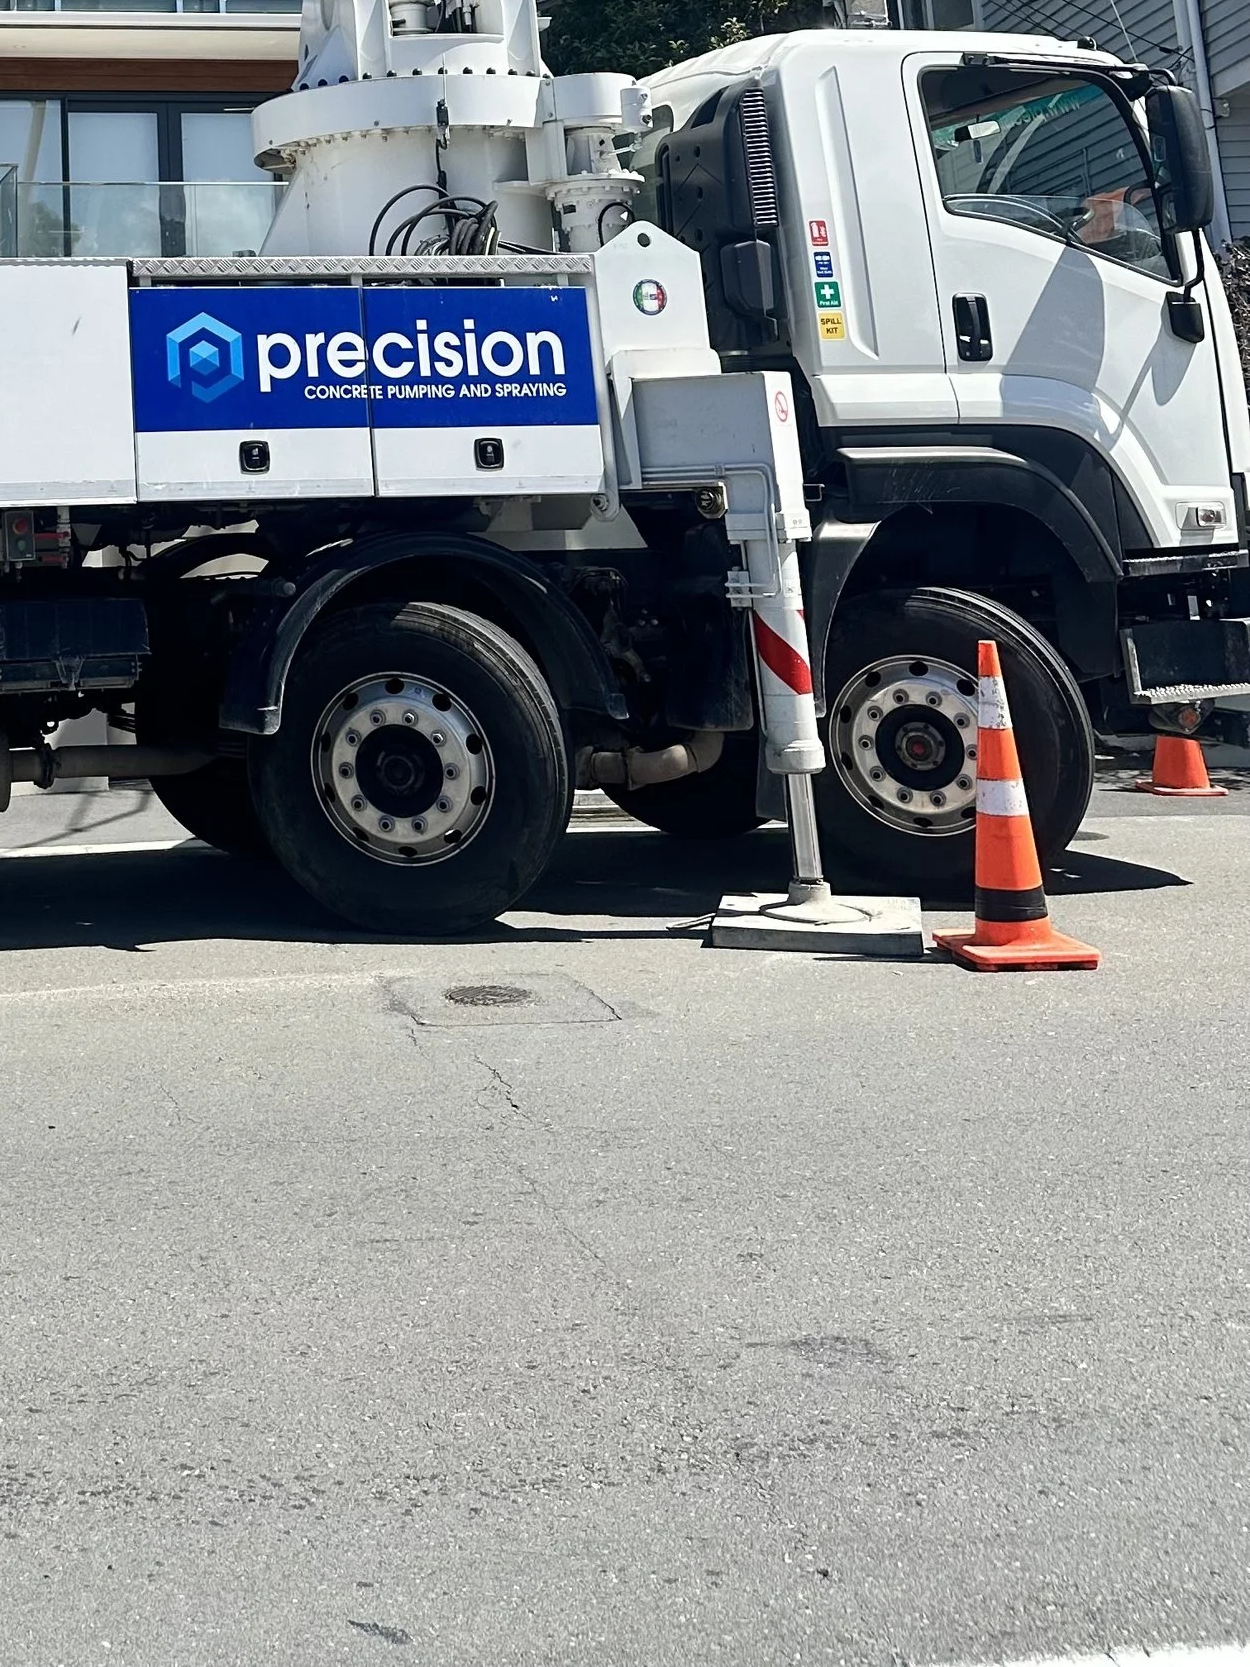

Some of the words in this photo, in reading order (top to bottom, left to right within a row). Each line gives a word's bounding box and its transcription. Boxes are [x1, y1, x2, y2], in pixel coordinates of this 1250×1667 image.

[820, 318, 842, 326] SPILL
[826, 327, 839, 335] KIT
[257, 319, 566, 393] precision
[304, 384, 383, 400] CONCRETE
[387, 383, 455, 399] PUMPING
[459, 383, 491, 398] AND
[495, 382, 567, 397] SPRAYING
